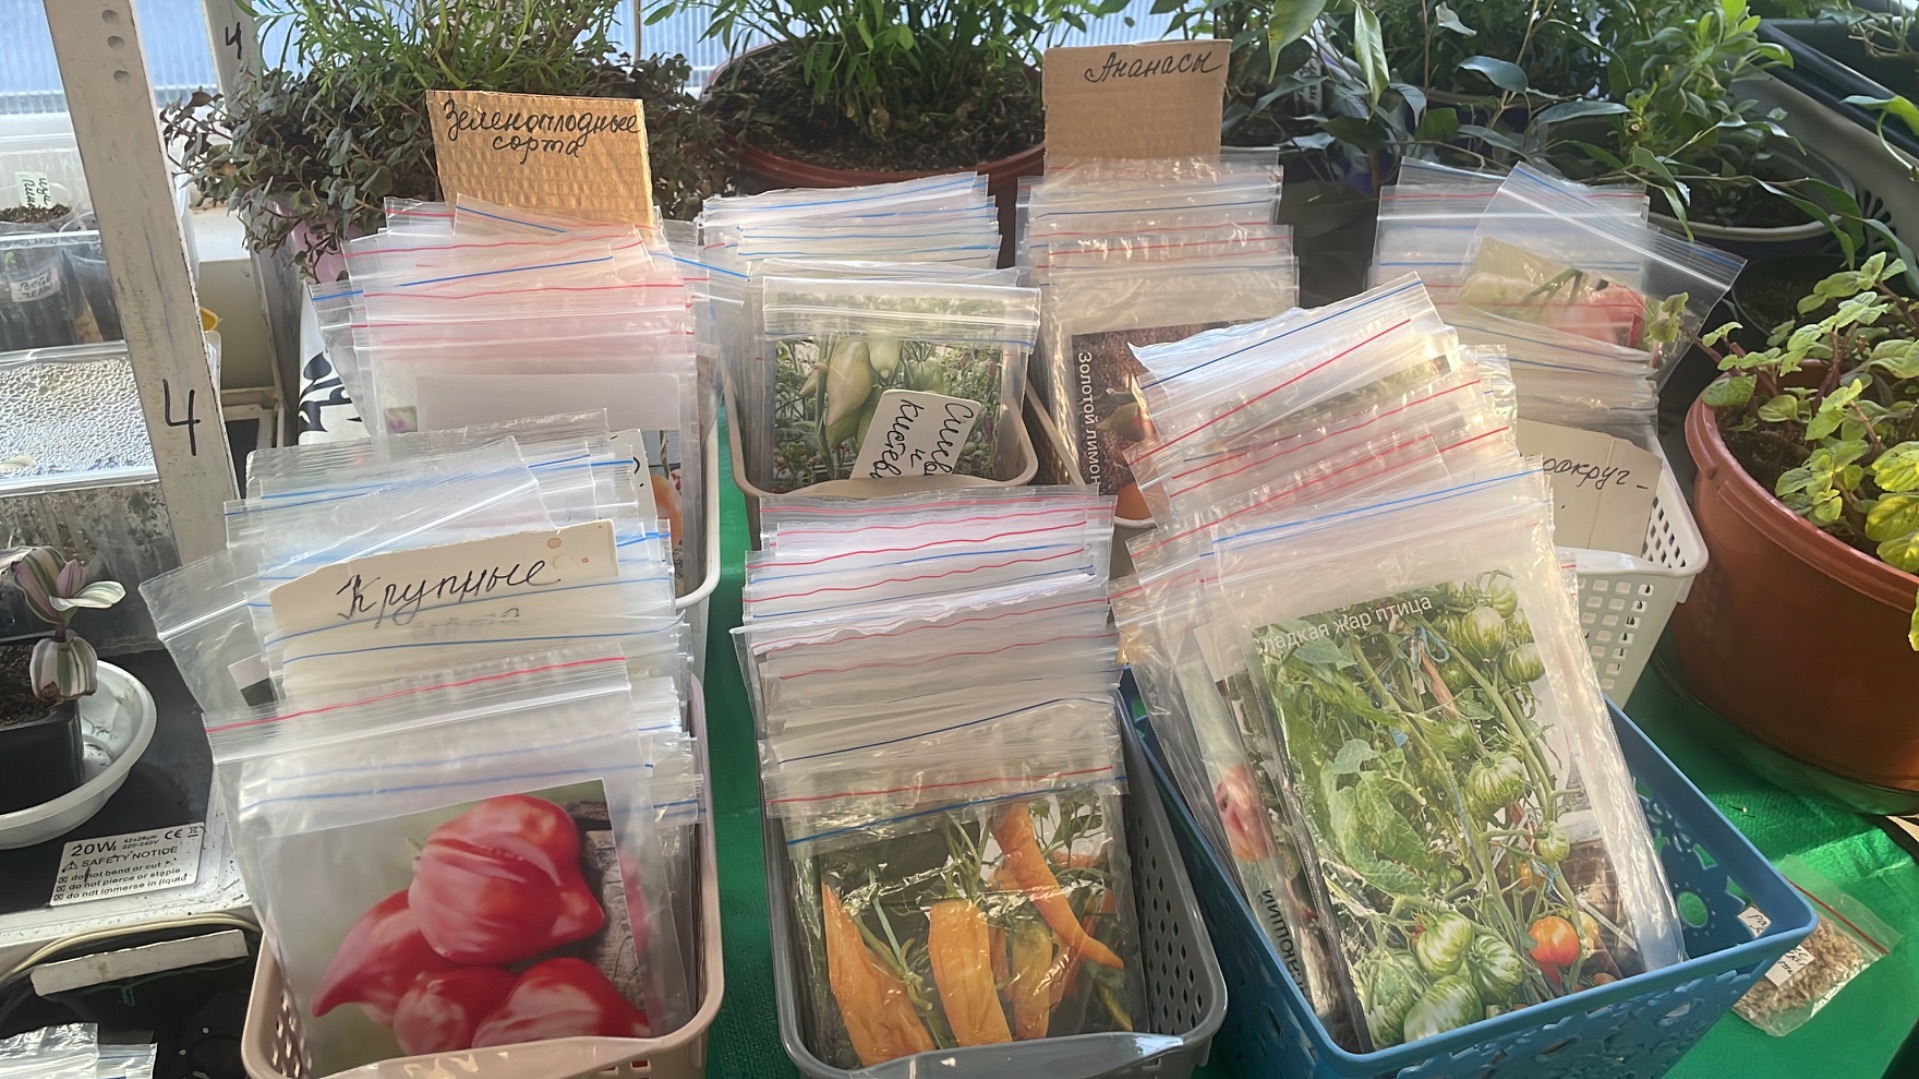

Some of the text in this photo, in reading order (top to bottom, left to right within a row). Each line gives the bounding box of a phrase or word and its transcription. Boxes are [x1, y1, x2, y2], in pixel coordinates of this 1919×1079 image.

[1084, 50, 1224, 83] Ананасы
[443, 98, 641, 147] Зеленоплодные
[492, 134, 579, 165] сорта
[1078, 351, 1099, 424] Золотой
[162, 378, 201, 457] 4
[336, 560, 562, 629] Крупные
[1333, 612, 1372, 635] жар
[1375, 596, 1433, 623] птица
[81, 853, 131, 867] SAFETY
[105, 866, 131, 877] bend
[132, 865, 144, 873] or
[145, 862, 161, 870] cut
[66, 892, 80, 900] do
[82, 889, 99, 898] not
[101, 882, 145, 896] immerse
[147, 879, 157, 887] in
[84, 880, 101, 888] not
[102, 875, 135, 887] pierce
[149, 867, 181, 878] staple
